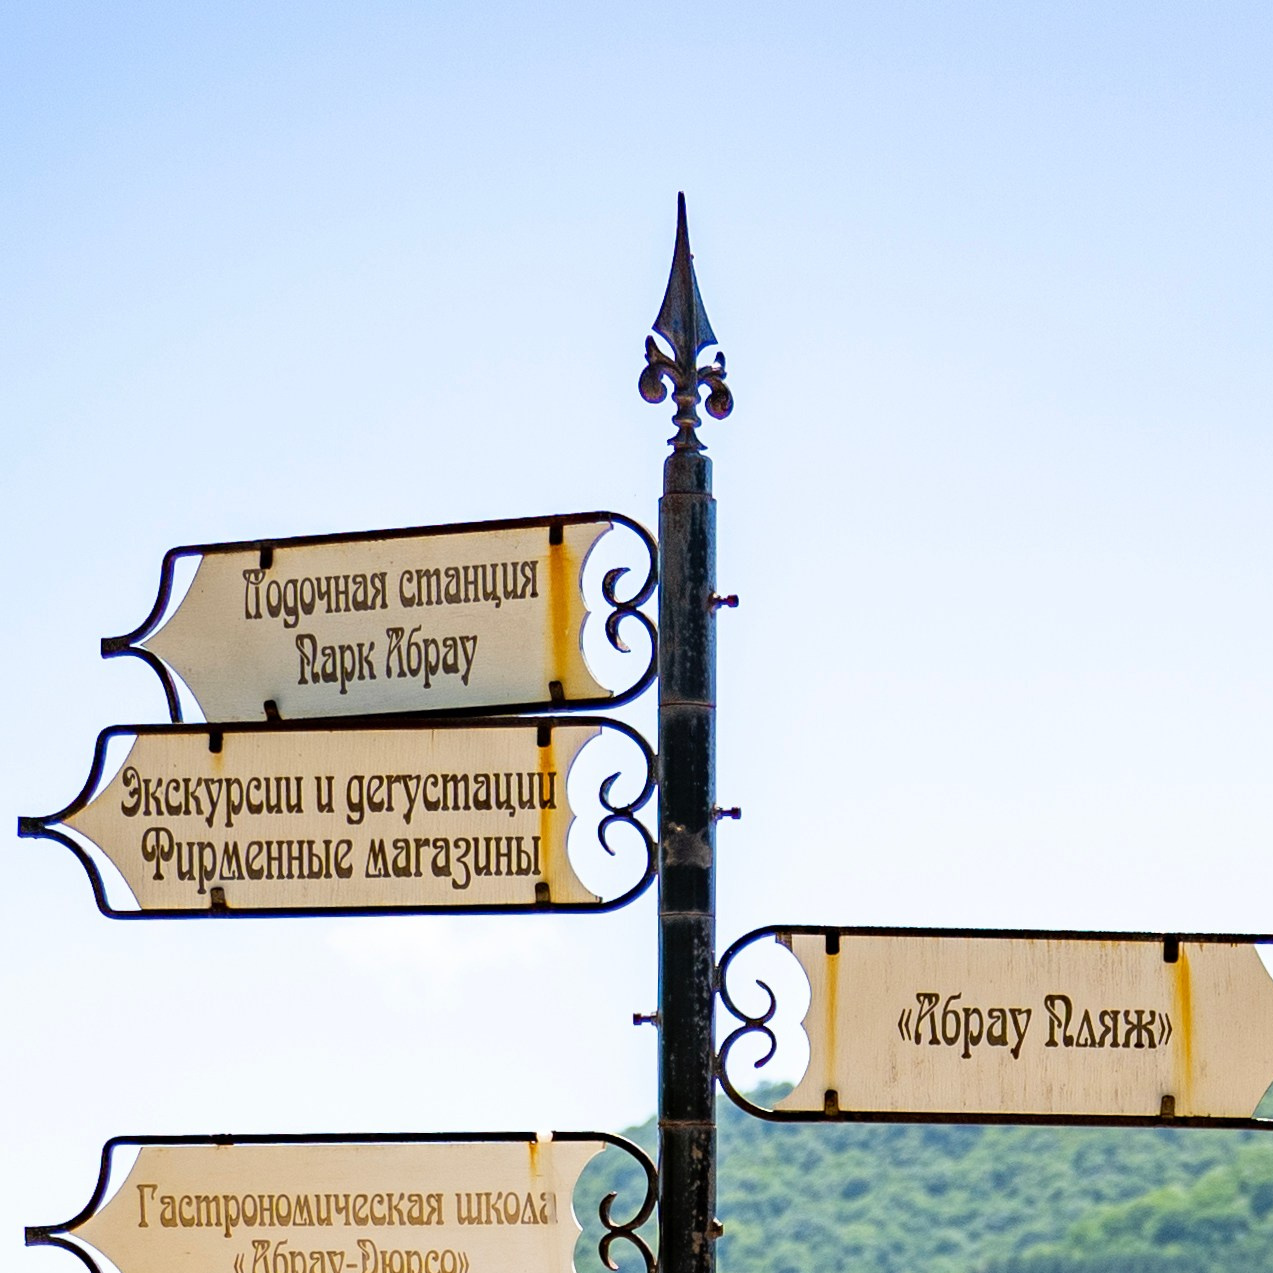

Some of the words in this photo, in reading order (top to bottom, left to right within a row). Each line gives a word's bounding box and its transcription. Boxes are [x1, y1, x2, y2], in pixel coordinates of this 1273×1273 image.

[242, 568, 389, 629] Лодочная
[398, 560, 539, 609] станция
[295, 633, 377, 695] Парк
[385, 624, 478, 690] Абрау
[120, 766, 304, 828] Экскурсии
[315, 775, 336, 814] и
[345, 771, 558, 825] дегустации
[141, 826, 354, 895] Фирменные
[364, 835, 542, 890] магазины
[897, 992, 1032, 1060] «Абрау
[1043, 994, 1173, 1049] Пляж»
[136, 1183, 445, 1239] Гастрономическая
[454, 1191, 557, 1226] школа
